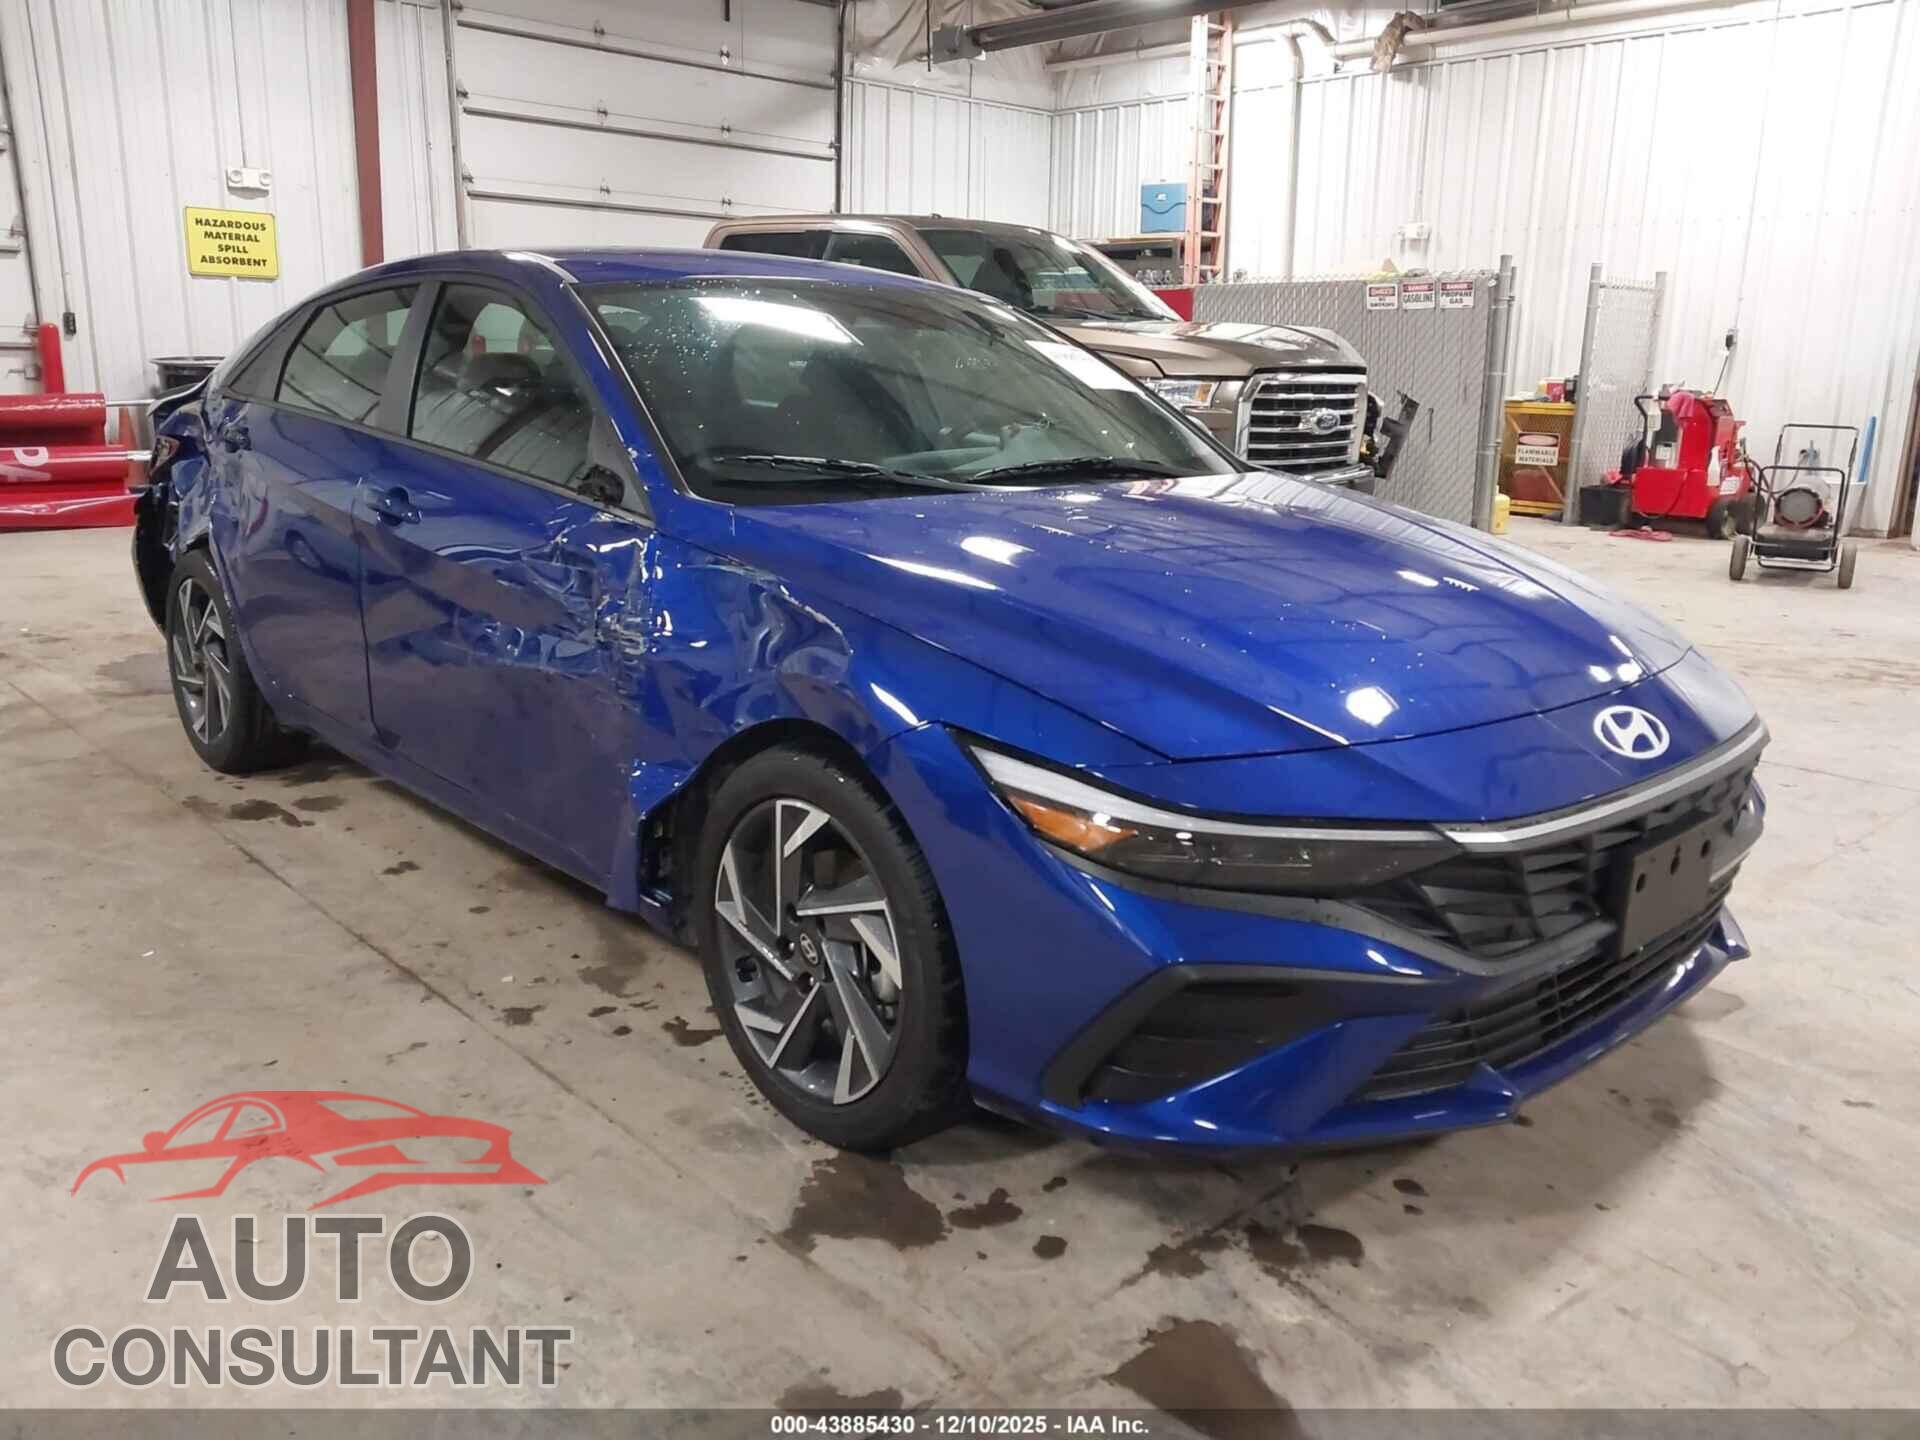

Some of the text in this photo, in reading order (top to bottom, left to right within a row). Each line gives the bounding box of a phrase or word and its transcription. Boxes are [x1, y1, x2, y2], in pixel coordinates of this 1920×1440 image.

[195, 218, 266, 231] HAZARDOUS
[204, 231, 260, 242] MATERIAL
[218, 244, 248, 253] SPILL
[201, 256, 267, 267] ABSORBENT
[1402, 293, 1433, 304] GASOLINE
[1518, 448, 1556, 457] FLAMMABLE
